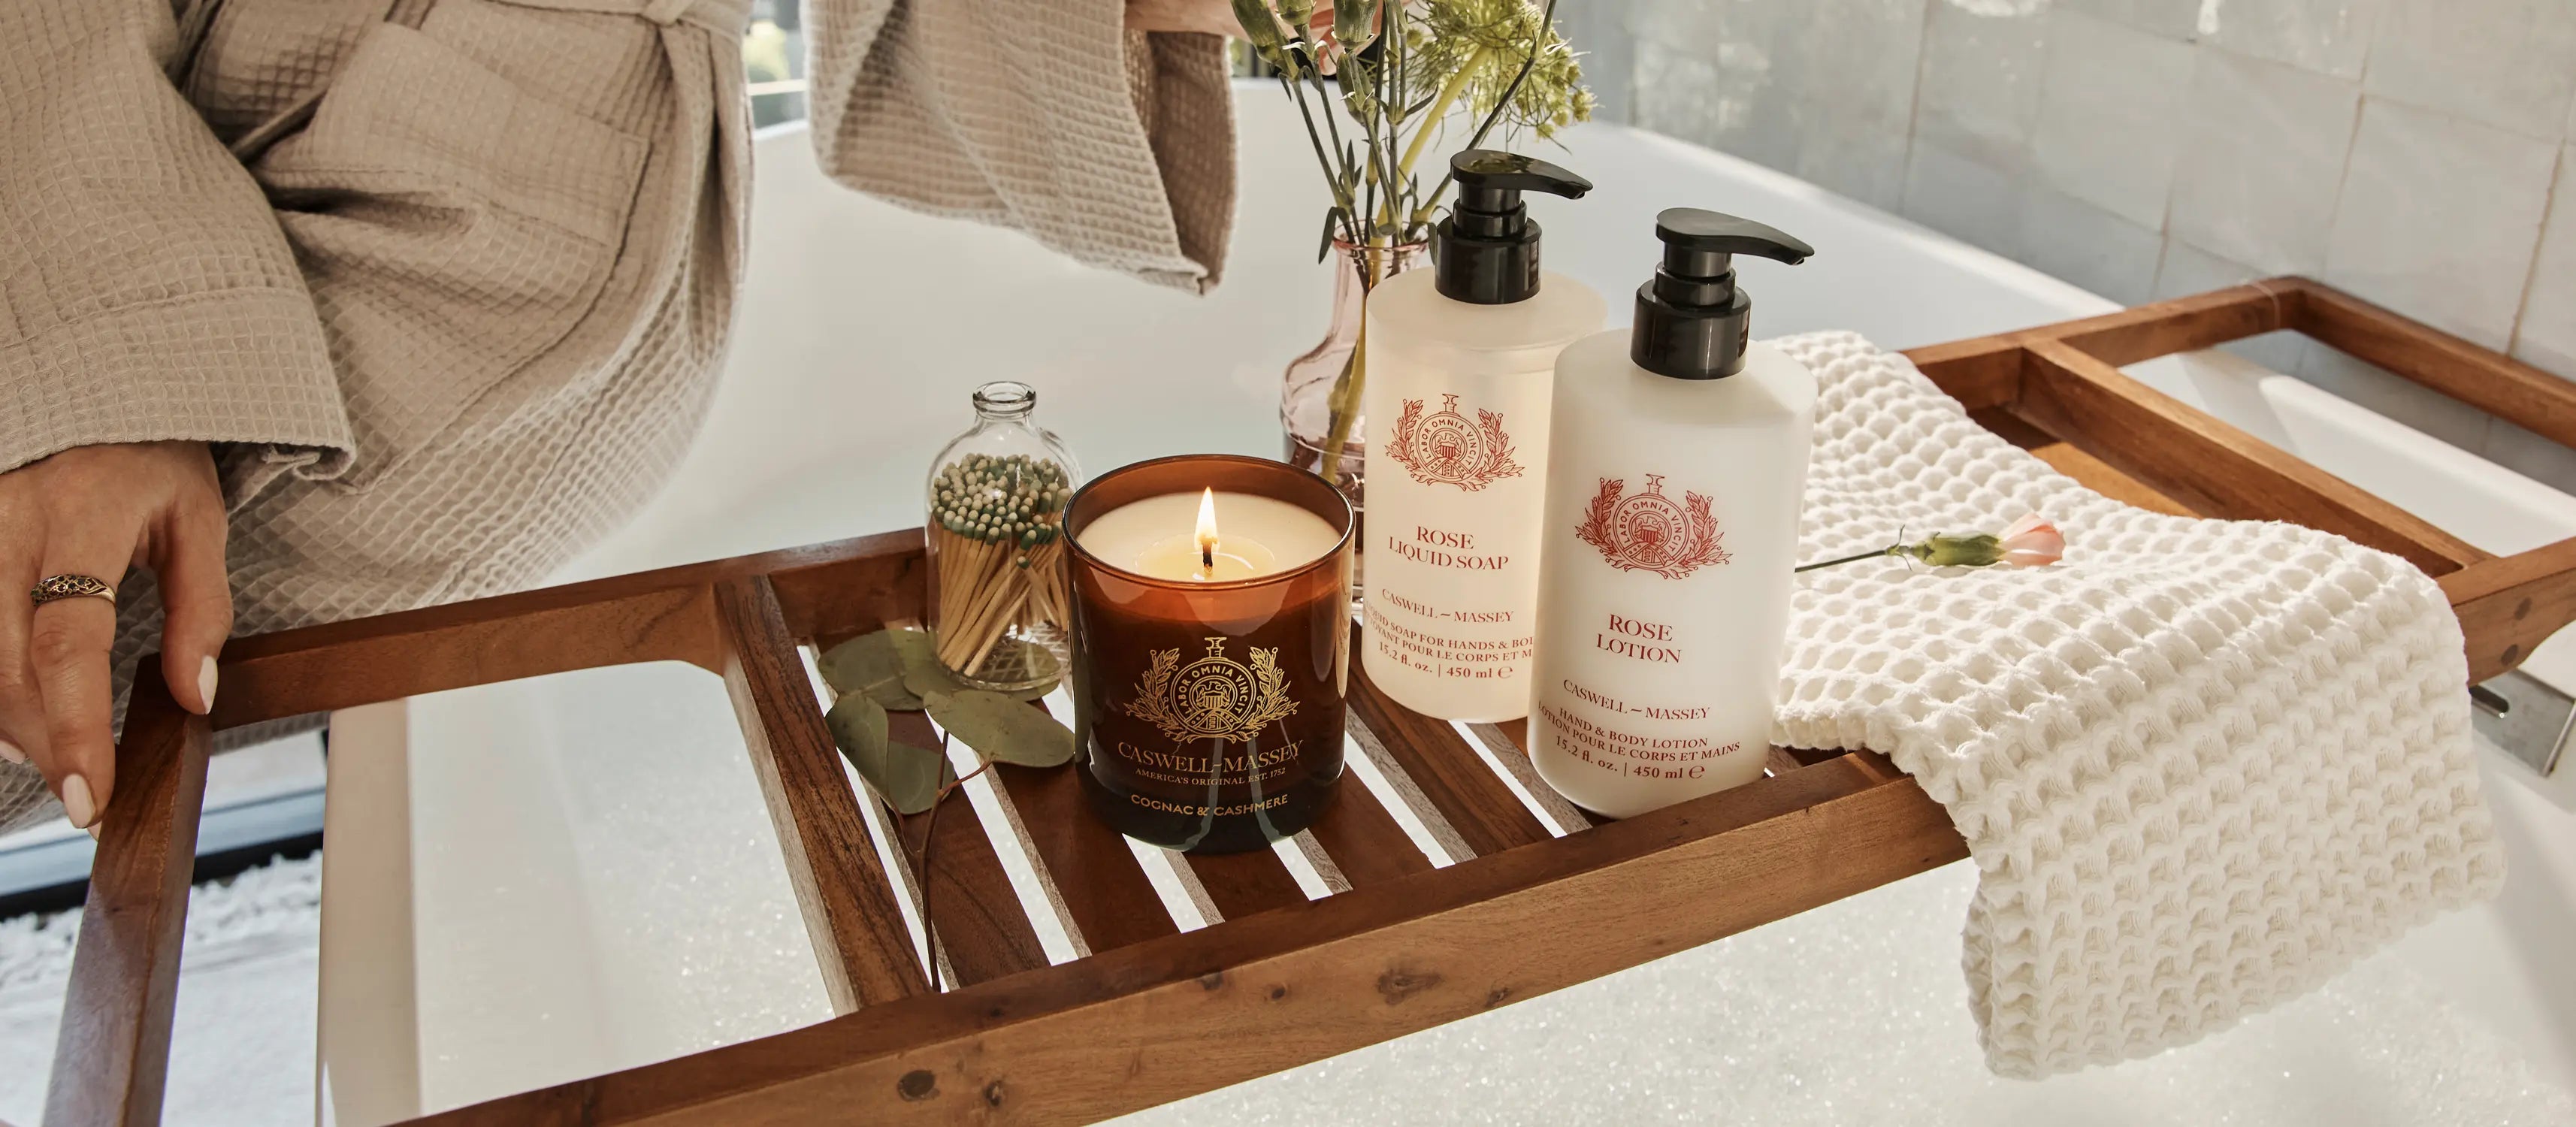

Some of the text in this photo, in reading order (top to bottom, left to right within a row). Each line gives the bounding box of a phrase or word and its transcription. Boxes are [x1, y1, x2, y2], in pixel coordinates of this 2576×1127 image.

[1421, 418, 1477, 466] LABOR OMNIA VINCIT
[1416, 525, 1474, 550] ROSE
[1619, 500, 1683, 551] LABOR OMNIA VINCIT
[1388, 536, 1509, 571] LIQUID SOAP
[1382, 588, 1438, 618] CASWELL
[1454, 611, 1514, 623] MASSEY
[1366, 600, 1389, 627] QUID
[1390, 622, 1416, 639] SOAP
[1420, 634, 1444, 647] FOR
[1449, 639, 1495, 651] HANDS
[1498, 641, 1507, 650] &
[1608, 613, 1673, 642] ROSE
[1380, 642, 1398, 660] 15.2
[1414, 662, 1432, 673] oz.
[1447, 666, 1471, 678] 450
[1475, 667, 1492, 678] ml
[1402, 639, 1433, 657] POUR
[1437, 650, 1453, 660] LE
[1456, 652, 1499, 662] CORPS
[1503, 651, 1519, 661] ET
[1595, 633, 1682, 663] LOTION
[1178, 665, 1249, 715] LABOR OMNIA VINCIT
[1563, 679, 1628, 714] CASWELL
[1646, 706, 1710, 720] MASSEY
[1537, 699, 1740, 762] LOTION POUR LE CORPS ET MAINS
[1559, 707, 1708, 749] HAND & BODY LOTION
[1556, 735, 1578, 757] 15.2
[1598, 760, 1618, 772] oz.
[1634, 765, 1660, 778] 450
[1664, 767, 1683, 779] ml
[1135, 767, 1286, 786] AMERICA'S ORIGINAL EST. 1752
[1130, 793, 1289, 817] COGNAC & CASHMERE
